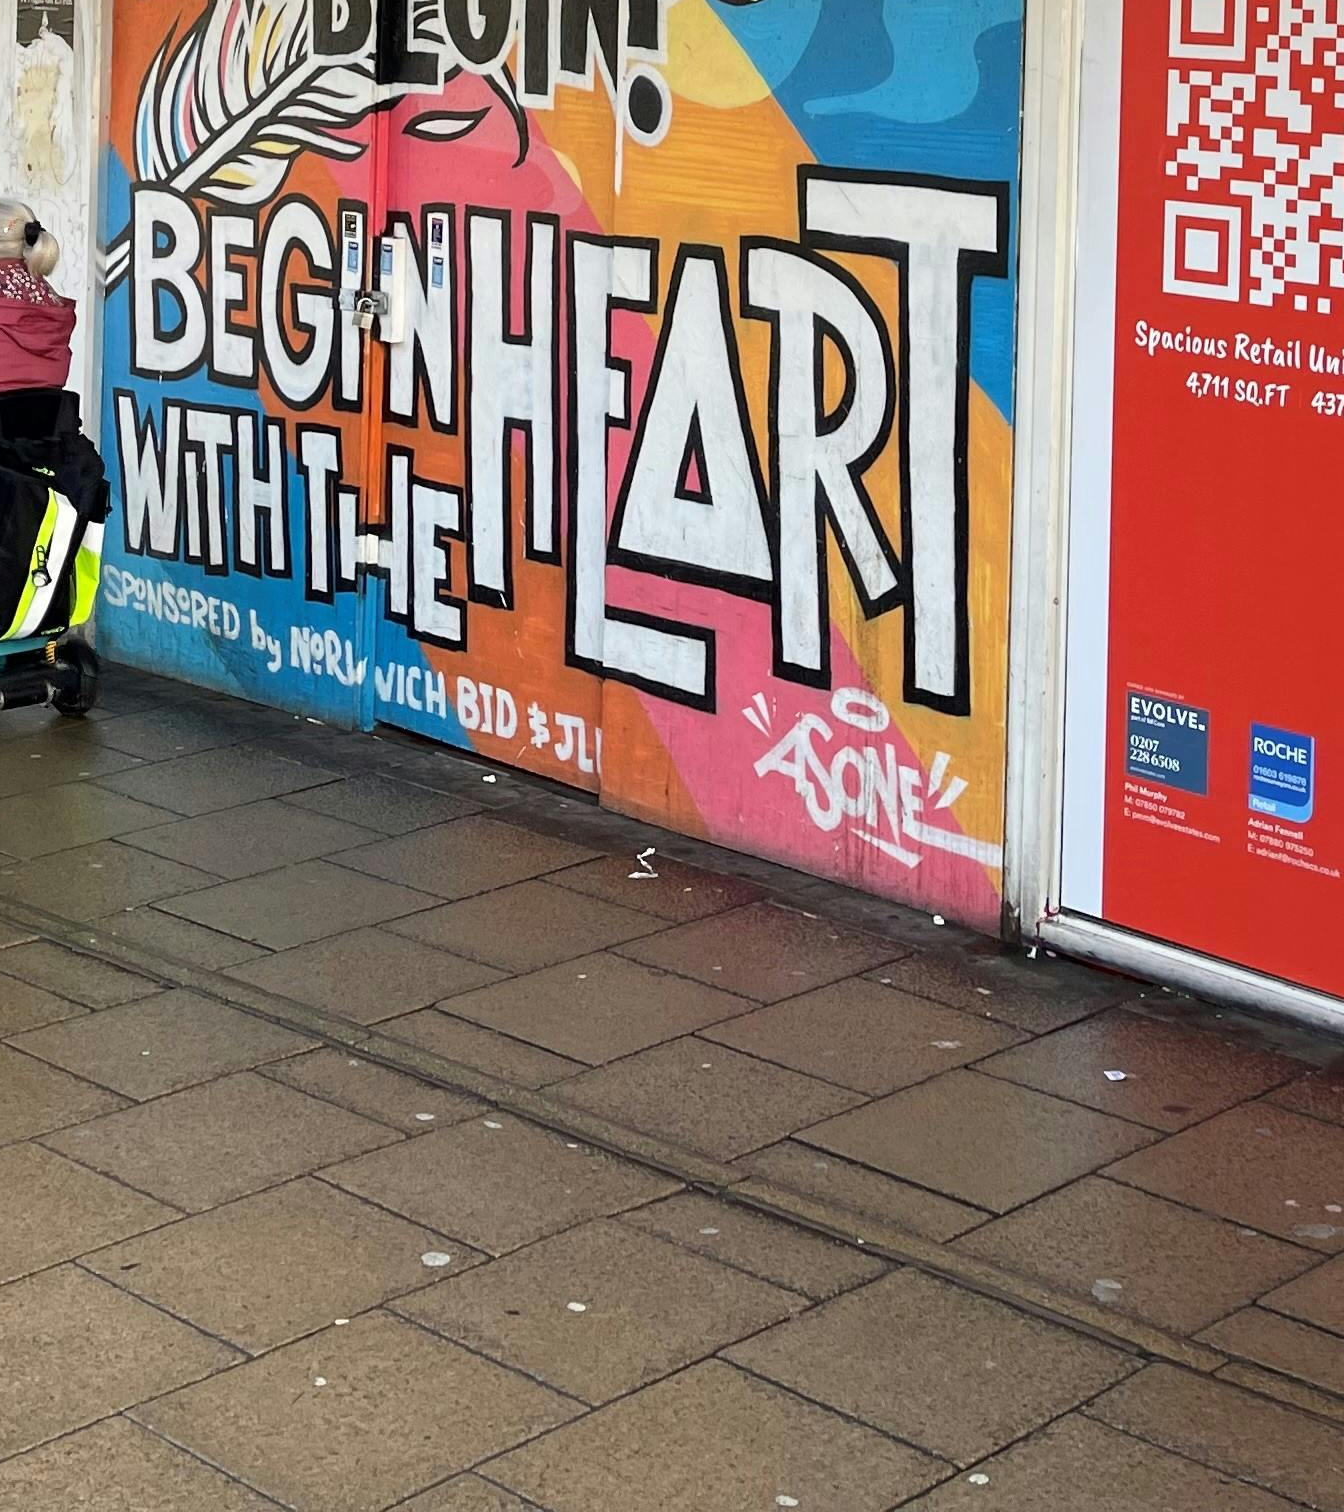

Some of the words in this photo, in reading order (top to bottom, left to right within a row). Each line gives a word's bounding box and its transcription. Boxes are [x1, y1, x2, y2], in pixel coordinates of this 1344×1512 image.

[128, 181, 456, 433] BEGIN
[1135, 319, 1228, 357] Spacious
[1234, 333, 1301, 369] Retail
[1186, 371, 1229, 398] 4,711
[1234, 378, 1290, 407] SQ.FT
[464, 165, 1013, 715] HEART
[114, 389, 291, 579] WITH
[297, 425, 468, 652] THE
[250, 609, 282, 672] by
[456, 677, 518, 740] BID
[1129, 748, 1150, 765] 228
[1130, 734, 1160, 752] 0207
[1253, 737, 1308, 765] ROCHE
